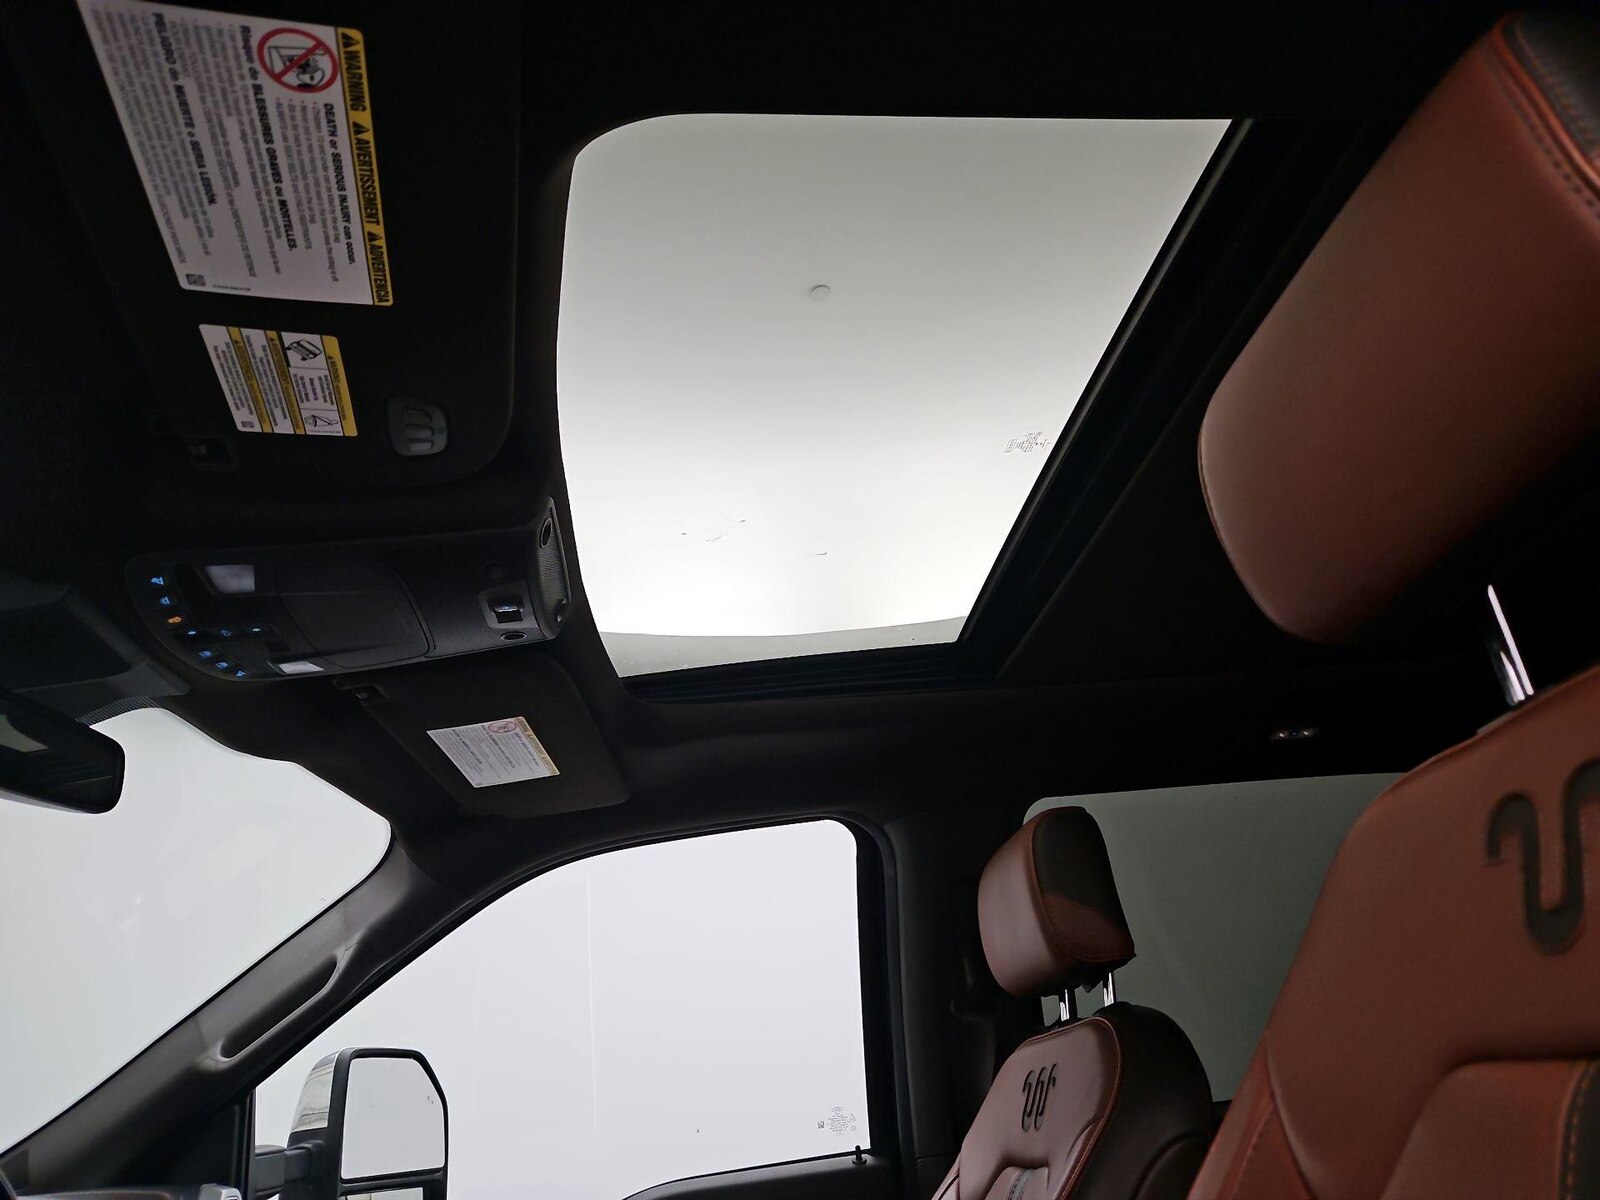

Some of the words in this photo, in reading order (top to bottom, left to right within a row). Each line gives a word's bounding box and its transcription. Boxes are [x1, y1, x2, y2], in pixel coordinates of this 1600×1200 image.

[152, 12, 176, 65] PELIGRO
[239, 25, 257, 64] Risque
[166, 66, 181, 82] de
[247, 66, 261, 81] de
[342, 49, 365, 112] WARNING
[171, 83, 195, 129] MUERTE
[251, 83, 274, 144] BLESSURES
[322, 102, 338, 137] DEATH
[188, 139, 207, 168] SERIA
[328, 139, 338, 149] or
[265, 146, 283, 184] GRAVES
[330, 151, 346, 192] SERIOUS
[354, 137, 379, 225] AVERTISSEMENT
[274, 186, 285, 197] ou
[337, 194, 351, 224] INJURY
[277, 199, 298, 251] MORTELLES.
[341, 225, 352, 240] can
[344, 241, 356, 265] occur.
[368, 241, 389, 303] ADVERTENCIA
